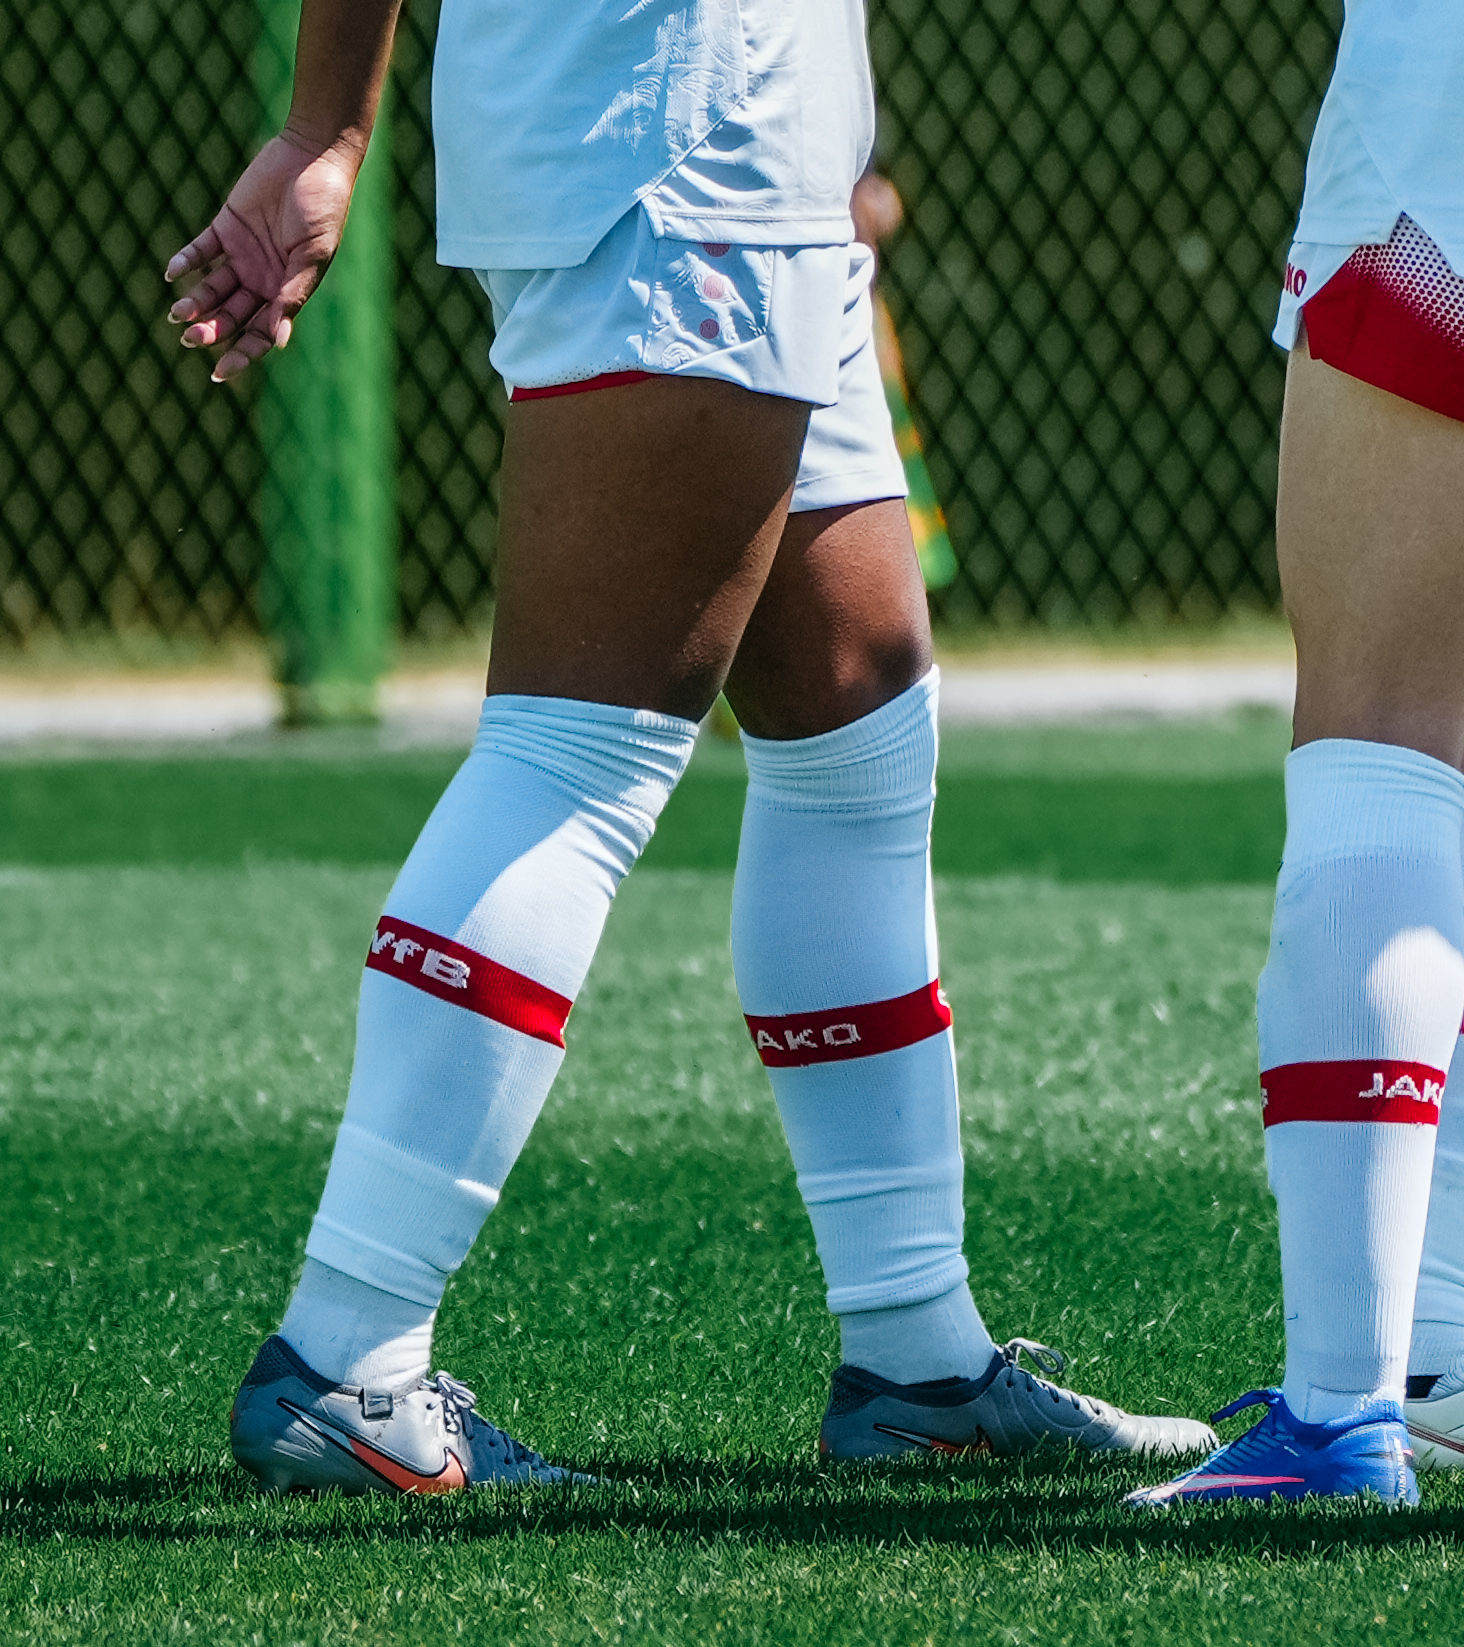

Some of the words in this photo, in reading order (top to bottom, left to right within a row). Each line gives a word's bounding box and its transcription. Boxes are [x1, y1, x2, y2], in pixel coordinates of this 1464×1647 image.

[371, 929, 471, 989] VfB
[756, 1023, 862, 1051] AKO
[1358, 1072, 1446, 1109] JAK
